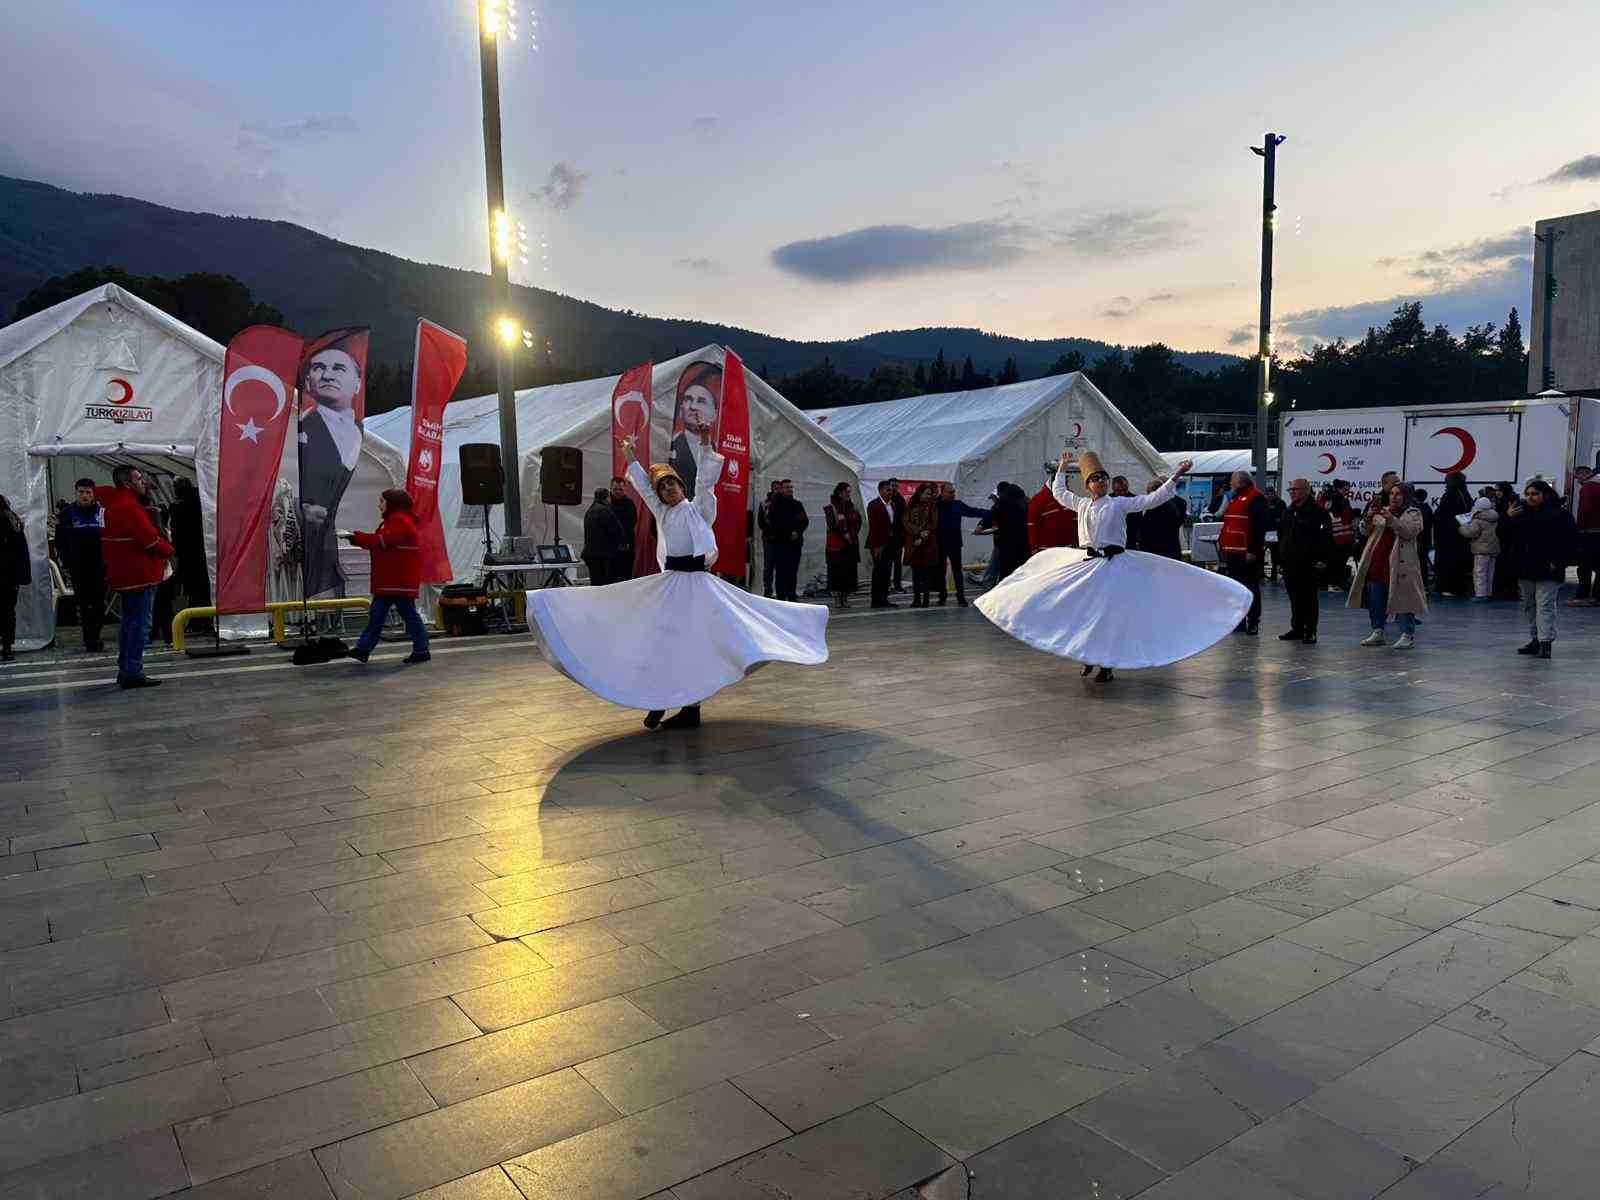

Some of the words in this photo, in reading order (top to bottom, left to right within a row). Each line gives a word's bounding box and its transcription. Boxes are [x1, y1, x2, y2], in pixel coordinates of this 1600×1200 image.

[1292, 429, 1324, 437] MERHUM
[1326, 428, 1352, 436] ORHAN
[1354, 427, 1385, 435] ARSLAN
[1294, 440, 1316, 448] ADINA
